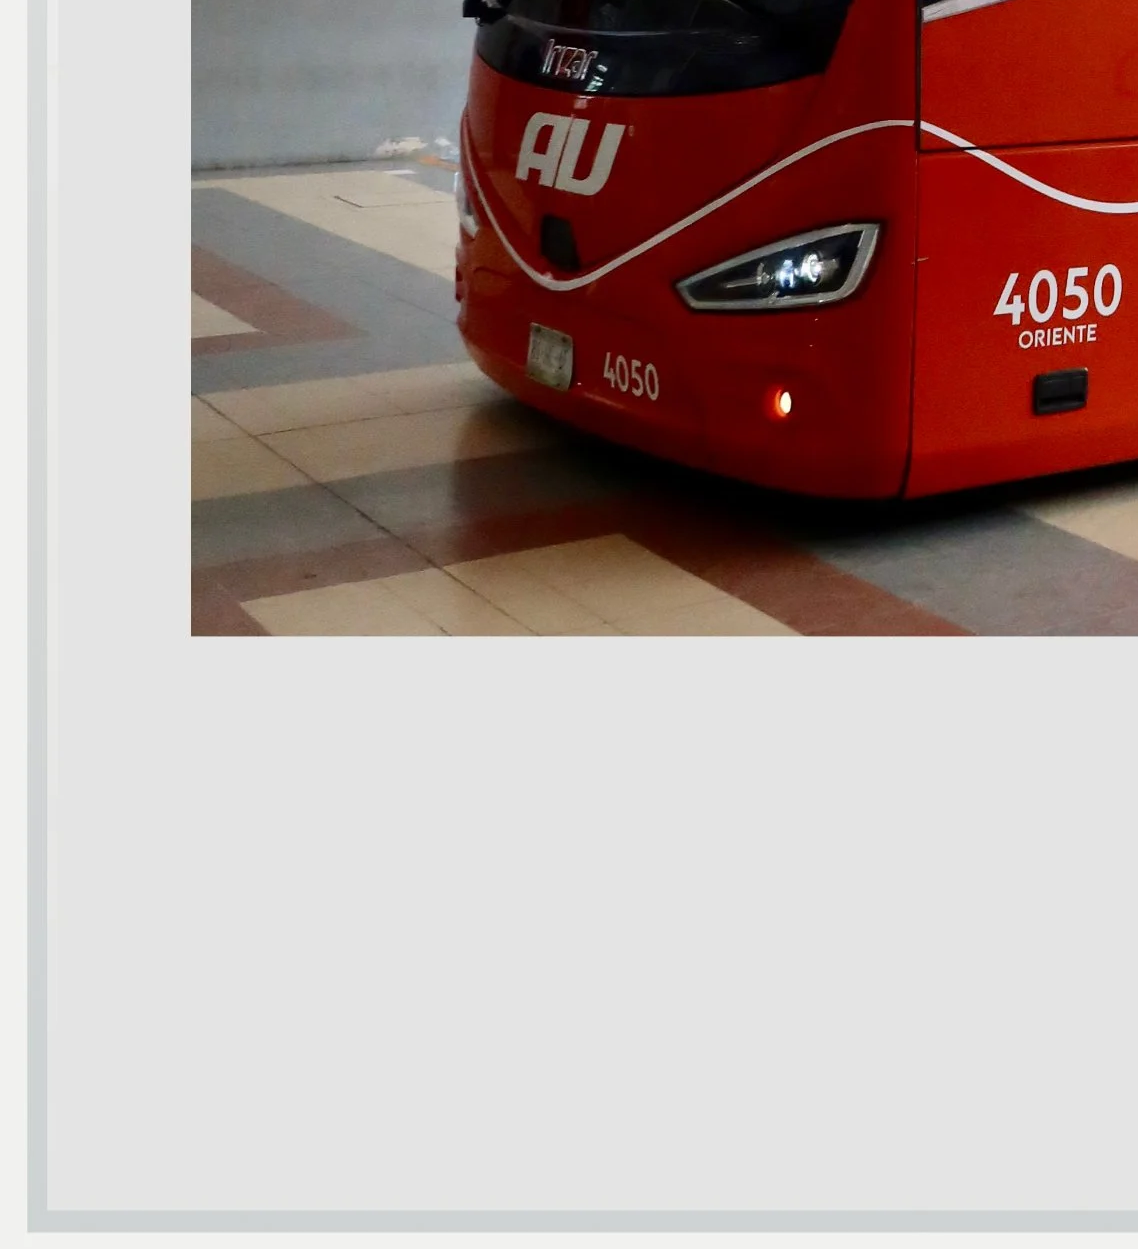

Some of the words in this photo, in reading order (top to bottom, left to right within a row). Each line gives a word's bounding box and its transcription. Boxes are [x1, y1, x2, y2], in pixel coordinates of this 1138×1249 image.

[515, 111, 627, 196] AU
[992, 263, 1123, 326] 4050
[1018, 323, 1098, 350] ORIENTE
[603, 351, 660, 401] 4050
